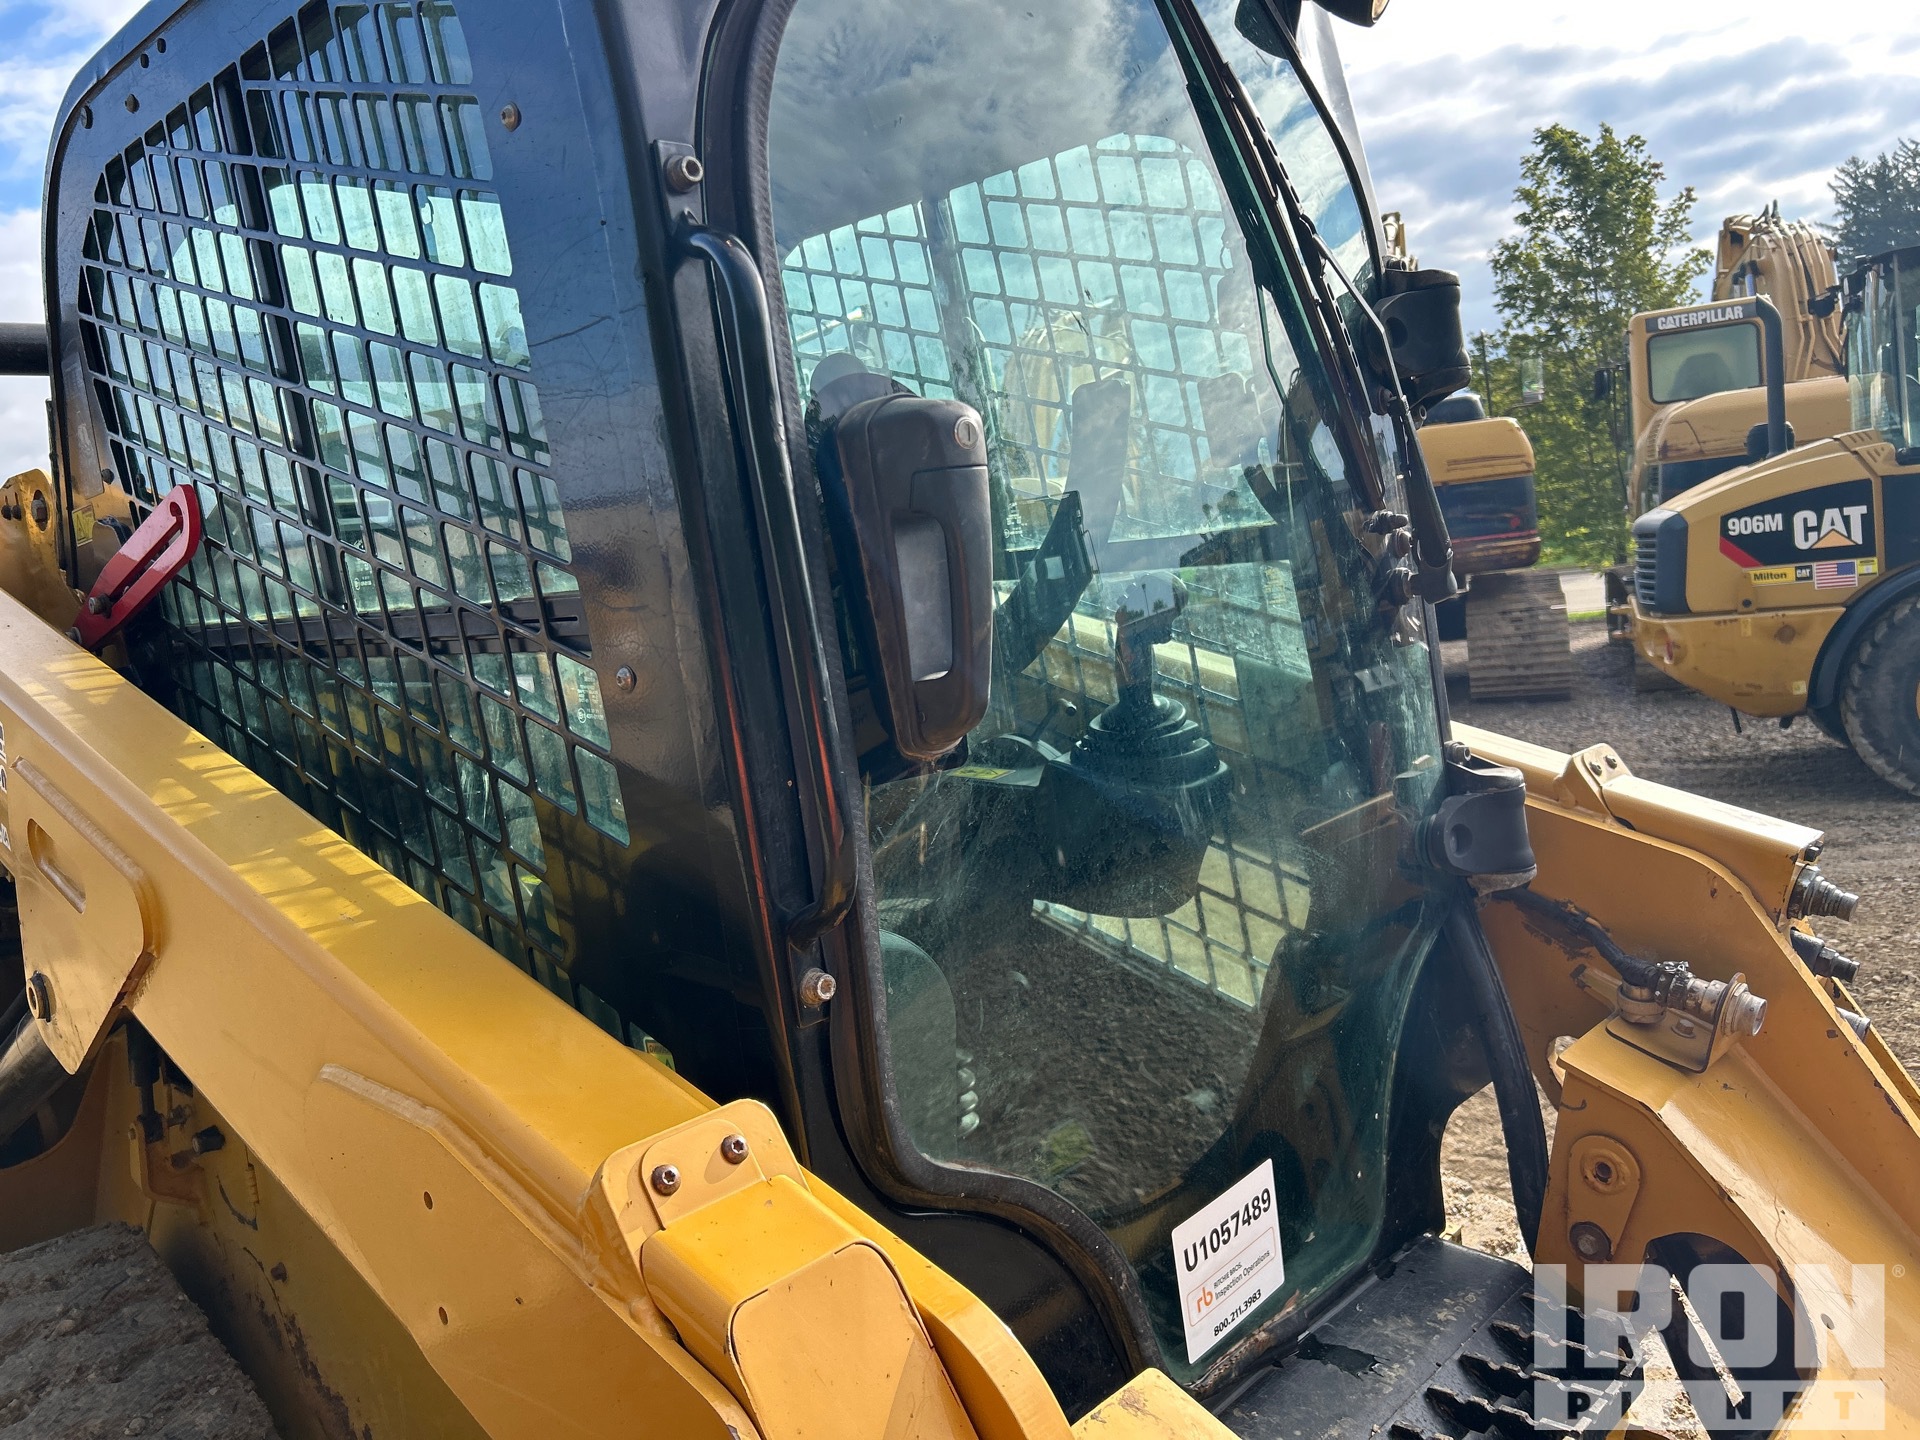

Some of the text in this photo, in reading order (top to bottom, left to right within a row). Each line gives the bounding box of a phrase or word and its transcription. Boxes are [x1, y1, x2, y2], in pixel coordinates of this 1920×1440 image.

[1657, 305, 1744, 330] CATERPILLAR
[1727, 513, 1784, 537] 906M
[1793, 505, 1868, 550] CAT
[1753, 572, 1787, 581] Milton
[1796, 568, 1811, 578] CAT
[1183, 1187, 1271, 1273] U1057489
[1215, 1250, 1271, 1300] Inspection Operations
[1197, 1286, 1213, 1313] rb
[1213, 1288, 1262, 1337] 800.211.3983
